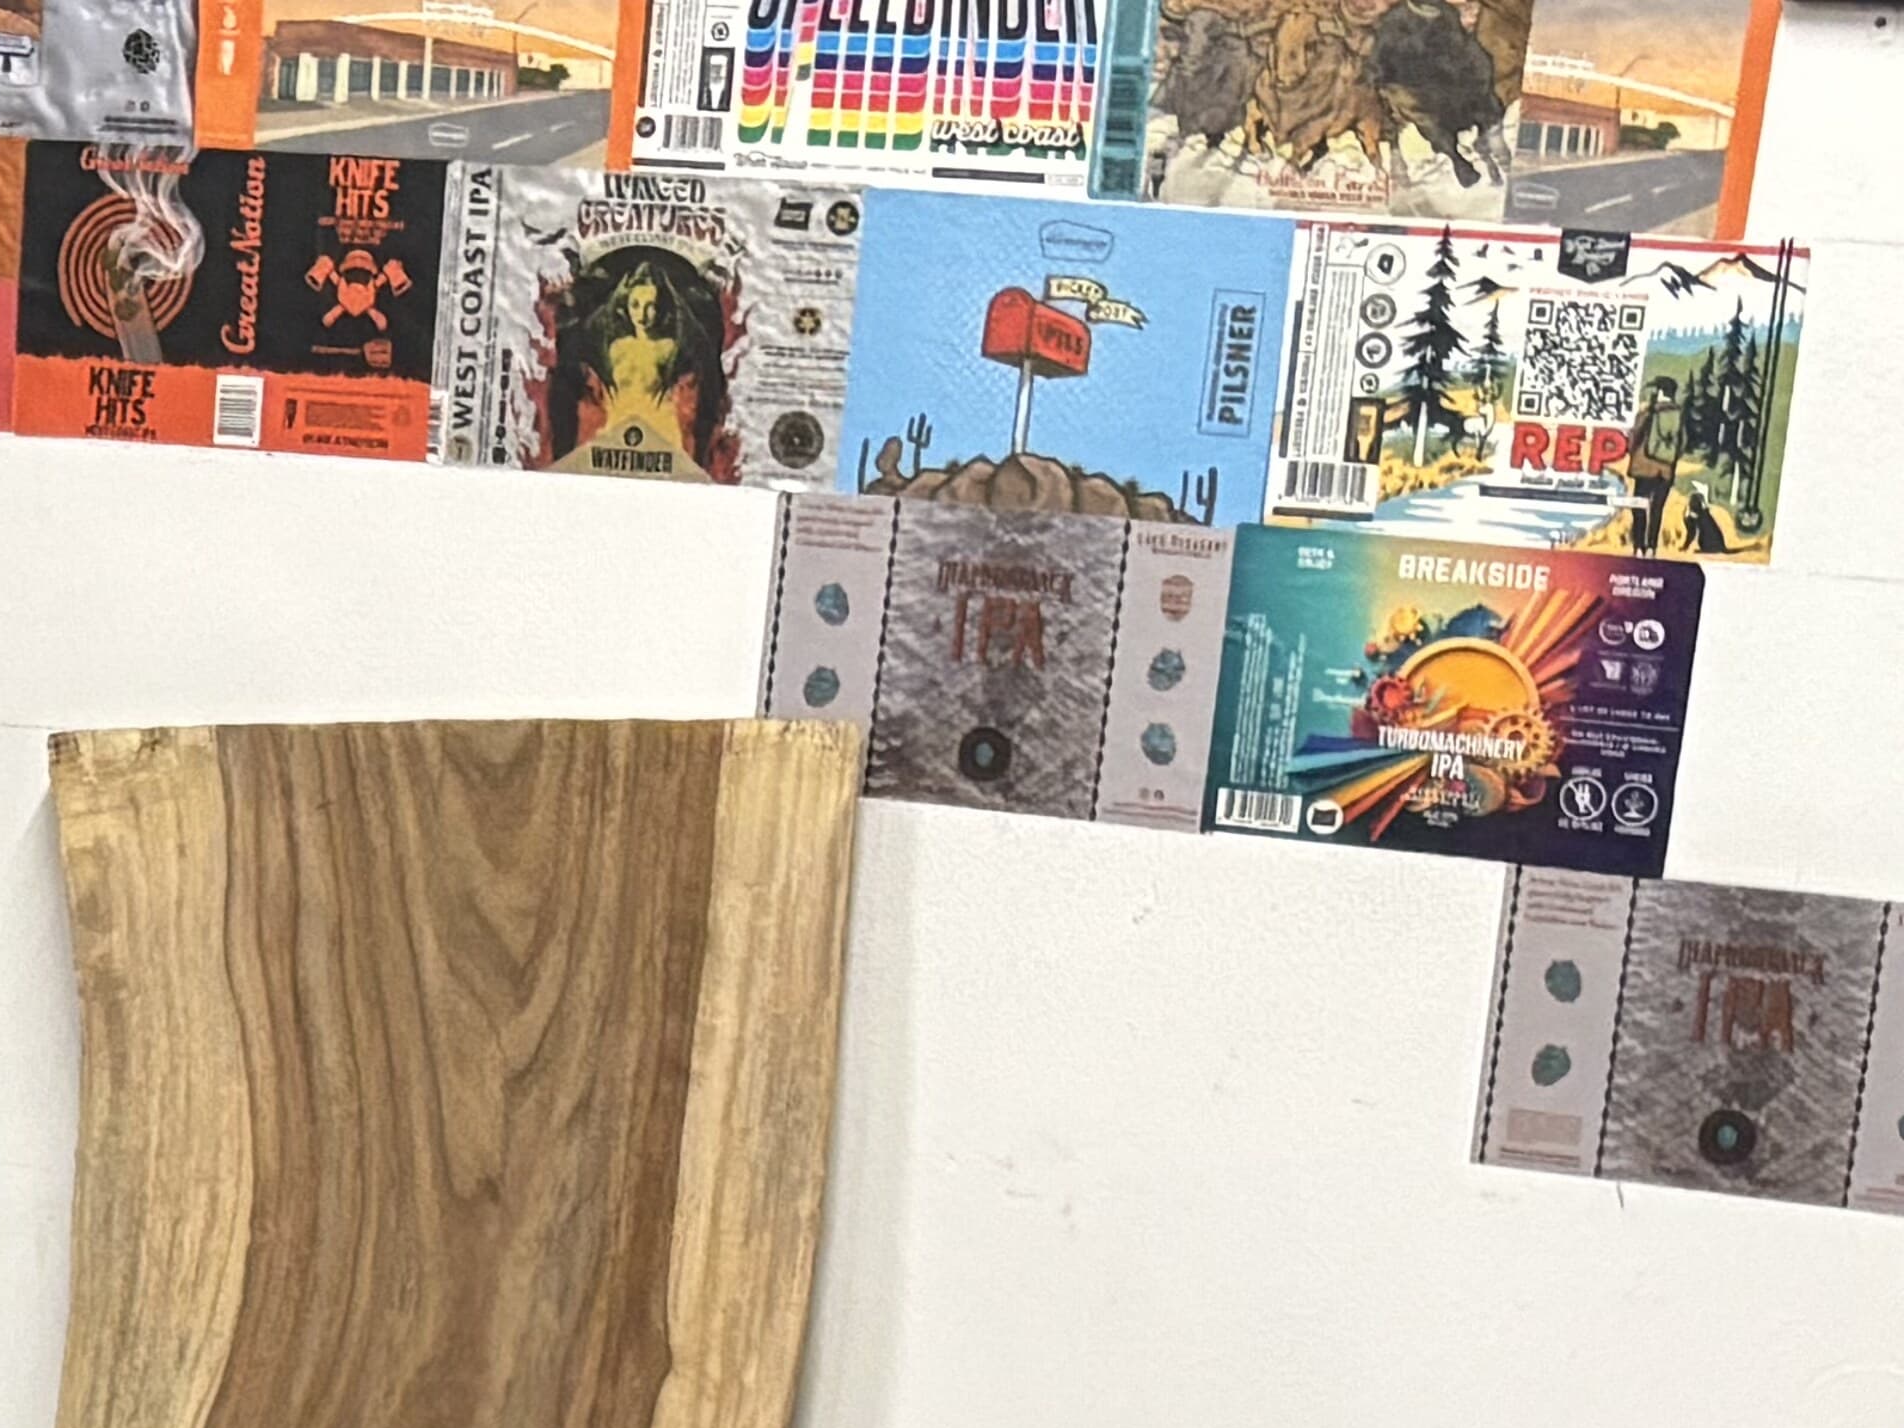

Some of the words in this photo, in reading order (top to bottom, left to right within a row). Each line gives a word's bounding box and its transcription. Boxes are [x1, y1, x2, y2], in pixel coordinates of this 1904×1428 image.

[931, 119, 999, 143] west
[1002, 122, 1082, 148] coast
[328, 156, 401, 191] KNIFE
[469, 168, 492, 217] IPA
[229, 156, 267, 250] Notion
[335, 188, 390, 218] HITS
[577, 198, 727, 247] CREATURES
[221, 250, 261, 355] Great
[460, 229, 487, 337] COAST
[88, 366, 156, 399] KNIFE
[452, 346, 478, 430] WEST
[1217, 304, 1257, 426] PILSNER
[95, 397, 146, 425] HITS
[1510, 421, 1630, 476] REP
[1398, 554, 1551, 592] BREAKSIDE
[951, 590, 1045, 672] IPA
[1377, 725, 1528, 761] TURBOMACHINERY
[1430, 752, 1465, 780] IPA
